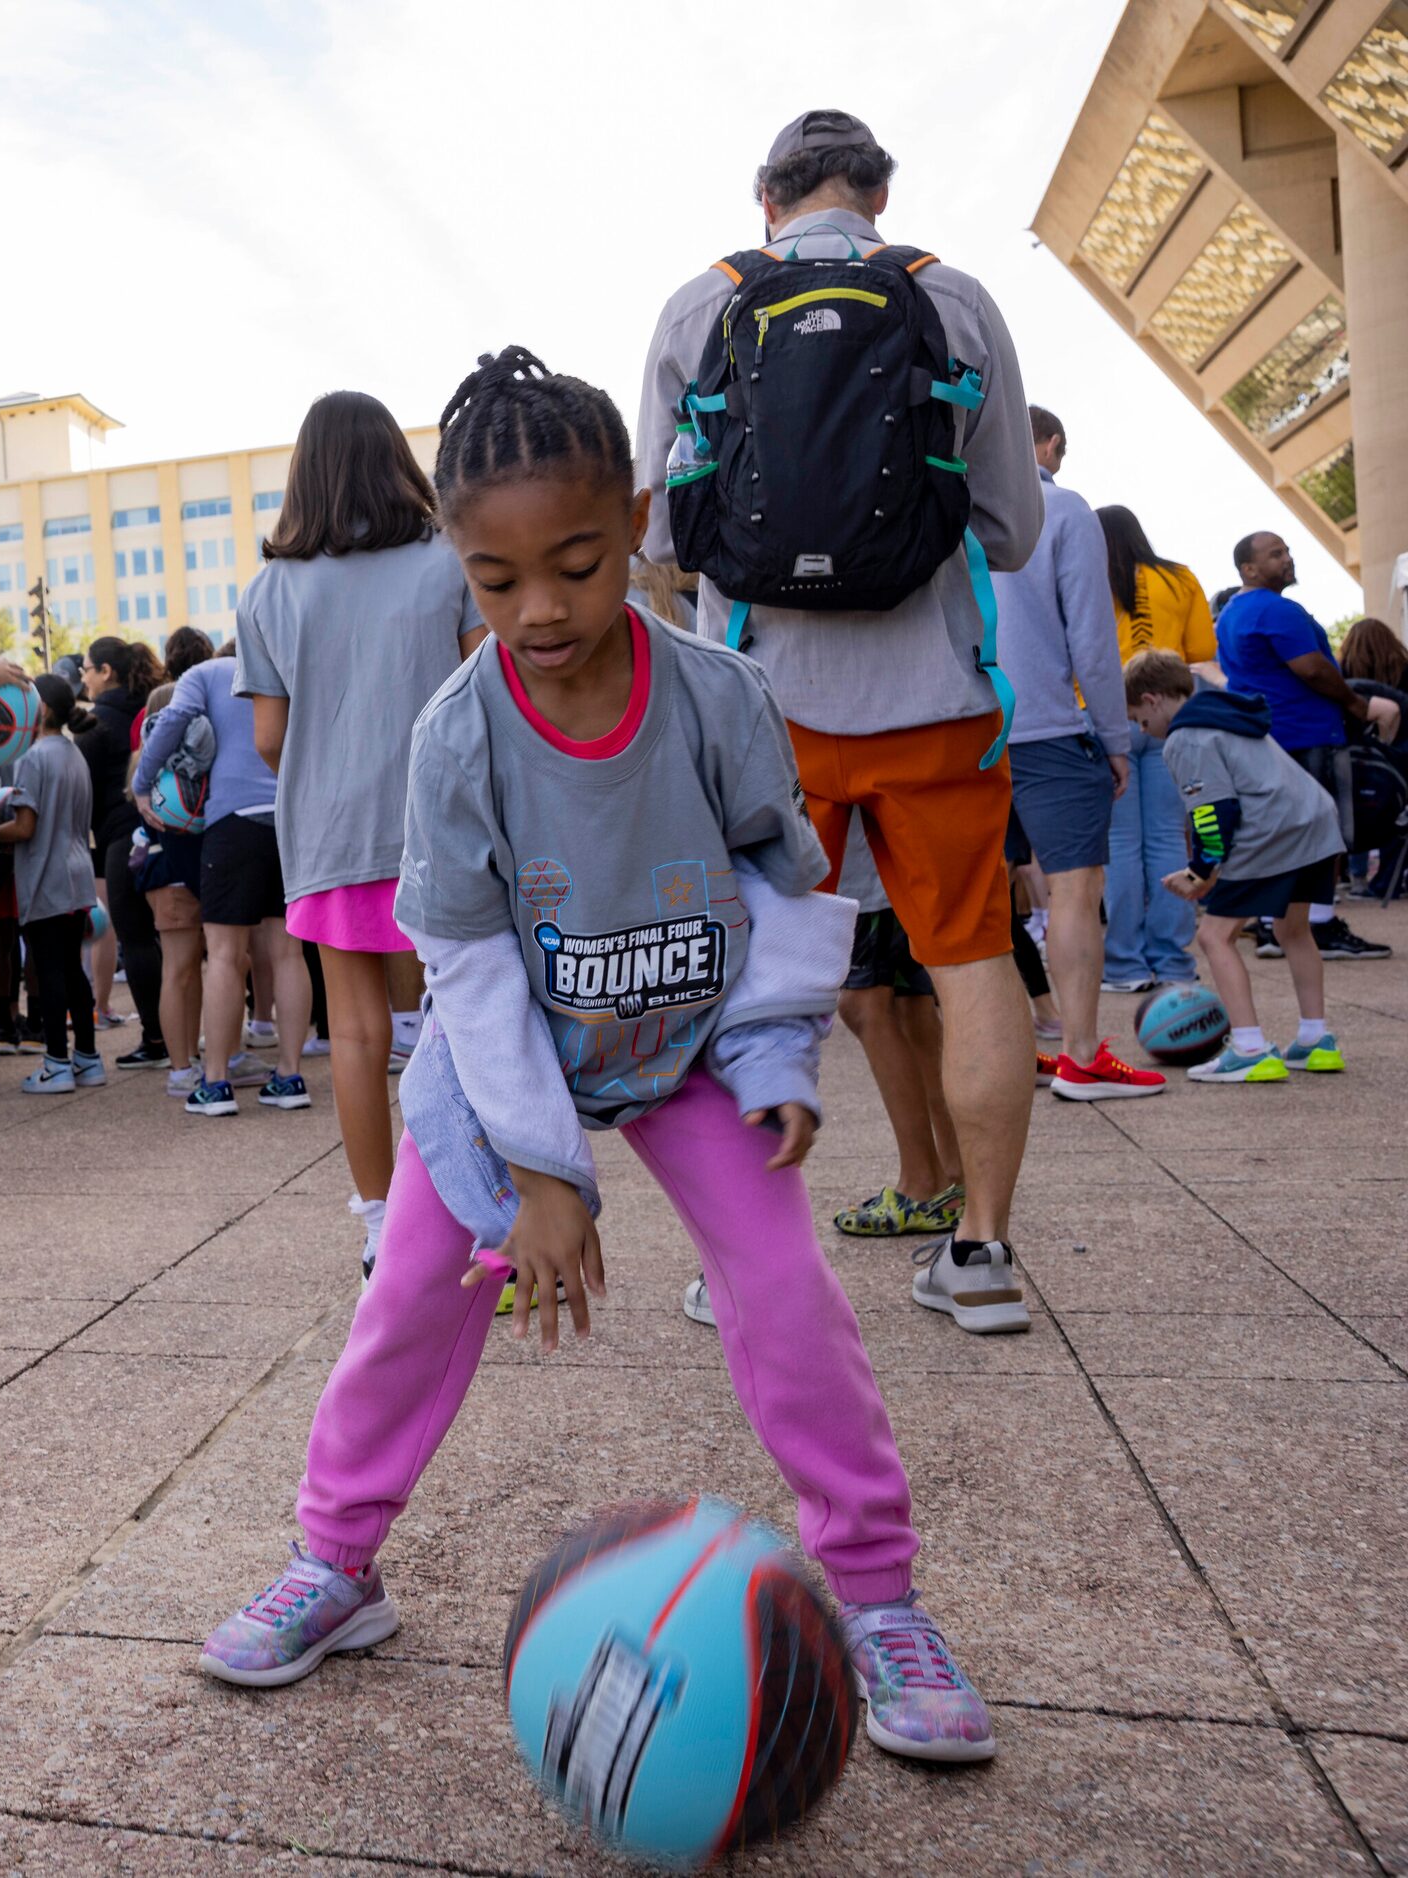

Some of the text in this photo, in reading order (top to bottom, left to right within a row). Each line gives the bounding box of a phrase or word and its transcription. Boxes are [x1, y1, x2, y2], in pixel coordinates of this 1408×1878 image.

[542, 936, 560, 946] NCAA
[564, 920, 703, 956] WOMEN'S FINAL FOUR
[556, 936, 710, 997] BOUNCE
[573, 996, 617, 1008] PRESENTED BY
[648, 986, 717, 1006] BUICK
